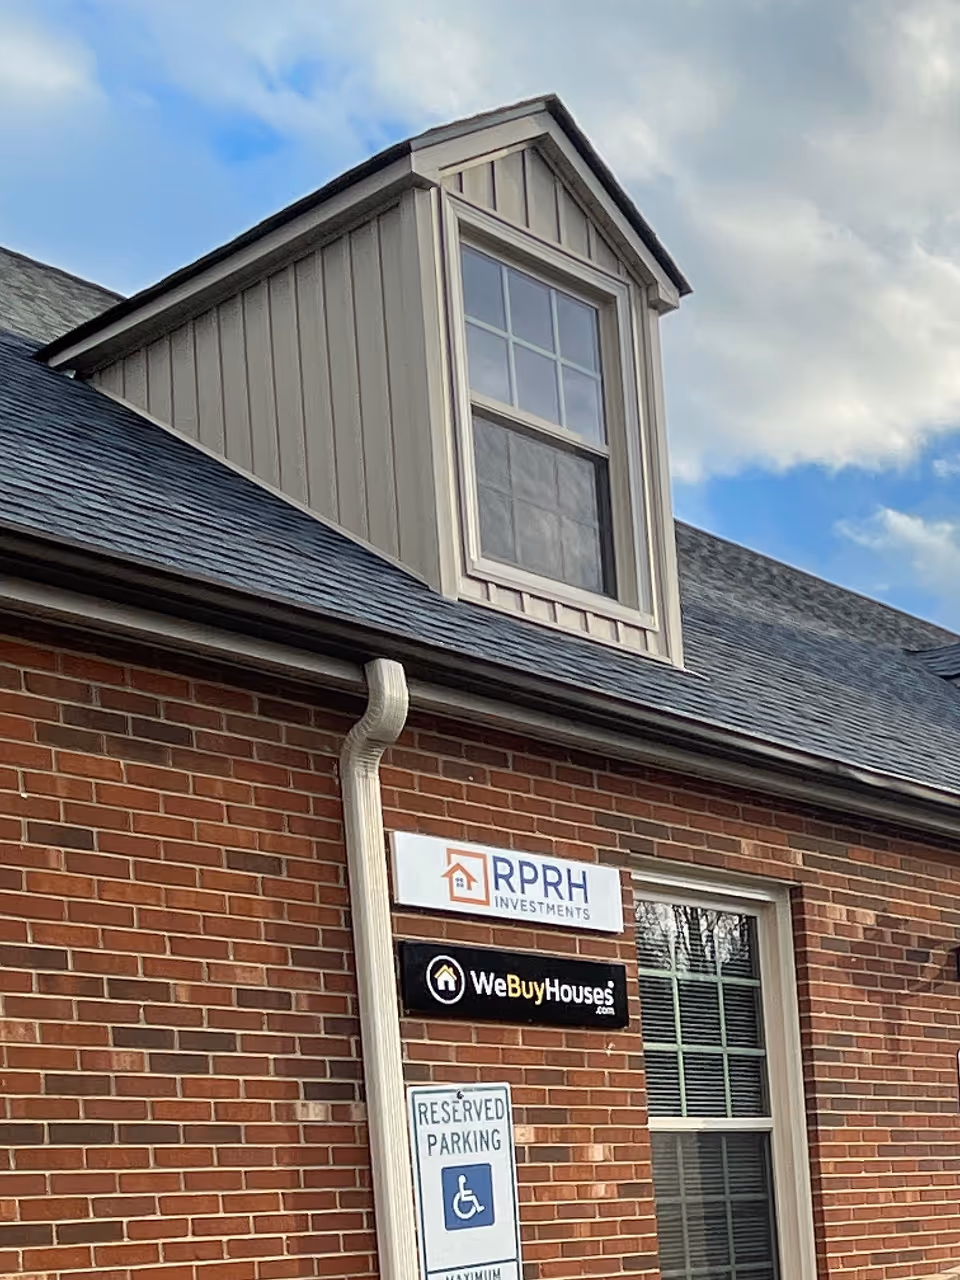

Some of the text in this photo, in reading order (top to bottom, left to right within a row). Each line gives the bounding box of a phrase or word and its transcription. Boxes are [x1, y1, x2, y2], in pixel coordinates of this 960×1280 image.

[492, 855, 589, 904] RPRH
[494, 895, 591, 921] INVESTMENTS
[470, 970, 614, 1006] WeBuyHouses
[418, 1097, 505, 1125] RESERVED
[427, 1128, 502, 1157] PARKING
